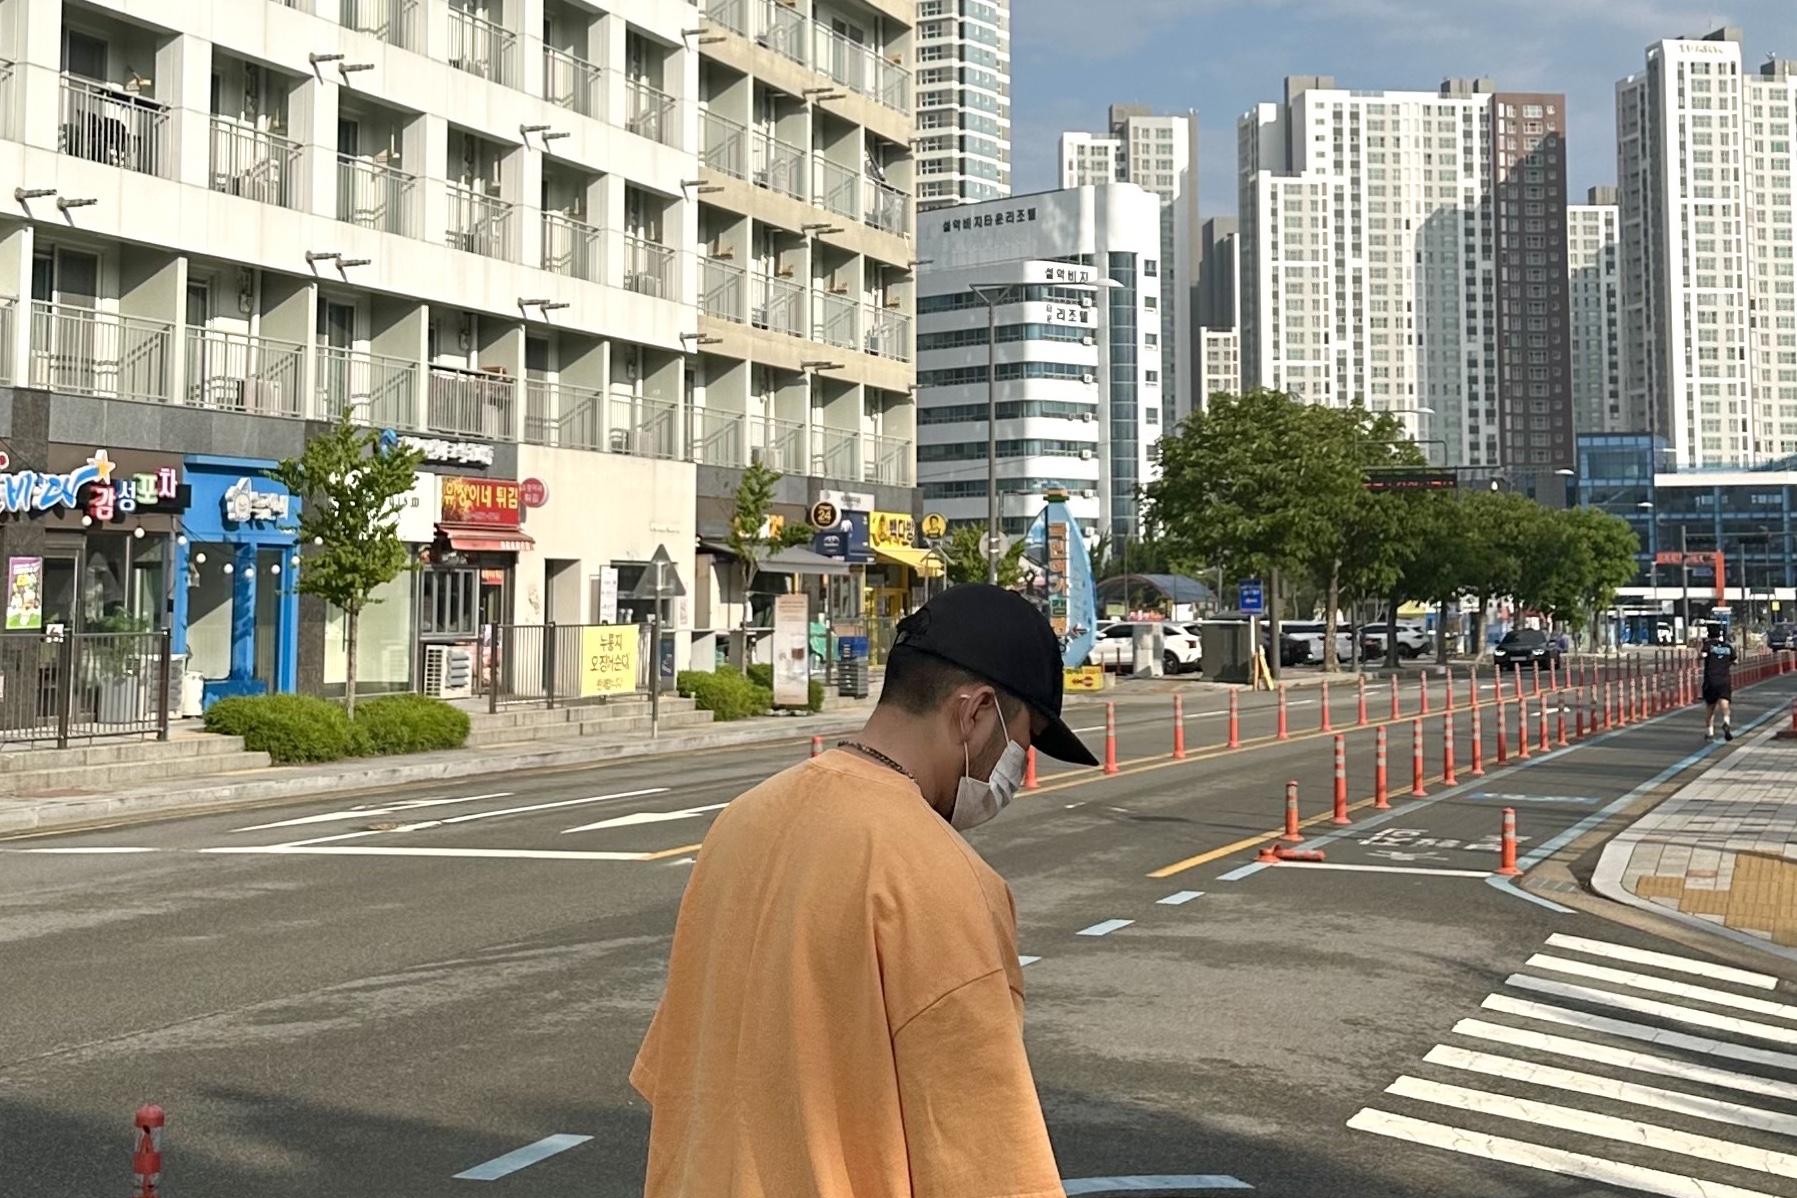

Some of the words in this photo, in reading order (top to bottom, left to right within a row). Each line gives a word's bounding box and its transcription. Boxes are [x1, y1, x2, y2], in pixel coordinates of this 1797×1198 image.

[92, 468, 178, 520] 감성포차
[495, 486, 519, 510] 튀김
[817, 510, 832, 521] 24
